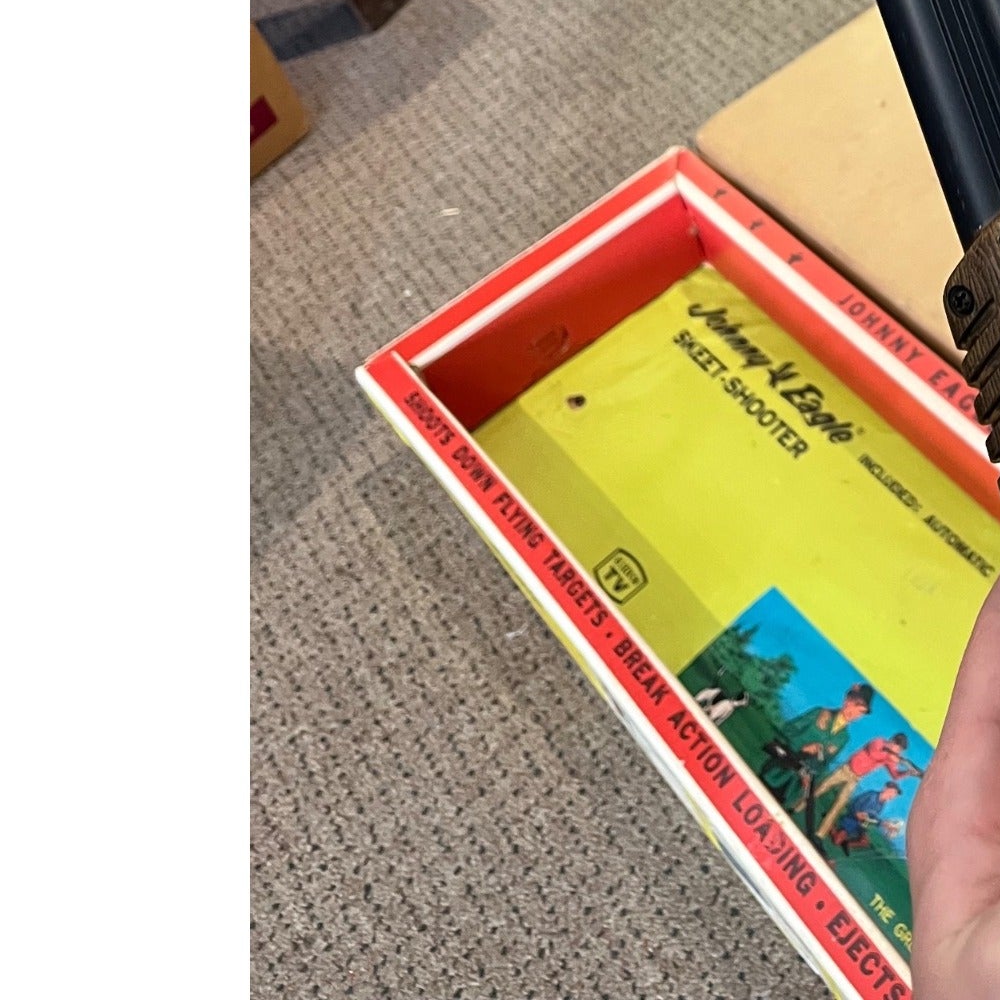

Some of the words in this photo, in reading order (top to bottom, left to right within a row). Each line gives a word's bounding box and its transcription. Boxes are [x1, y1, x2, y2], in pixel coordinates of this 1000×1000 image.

[673, 329, 808, 459] SKEET-SHOOTER
[688, 303, 771, 370] Johnny
[779, 383, 853, 444] Eagle
[839, 293, 923, 362] JOHNNY
[928, 369, 980, 420] EAG
[604, 566, 629, 593] TV
[923, 514, 996, 577] AUTOMATIC
[404, 391, 455, 446] SHOOTS
[452, 445, 498, 493] DOWN
[492, 491, 544, 549] FLYING
[543, 548, 608, 628] TARGETS
[613, 637, 669, 706] BREAK
[668, 711, 737, 789] ACTION
[732, 789, 817, 897] LOADING
[825, 911, 907, 1000] EJECTS
[869, 892, 896, 925] THE
